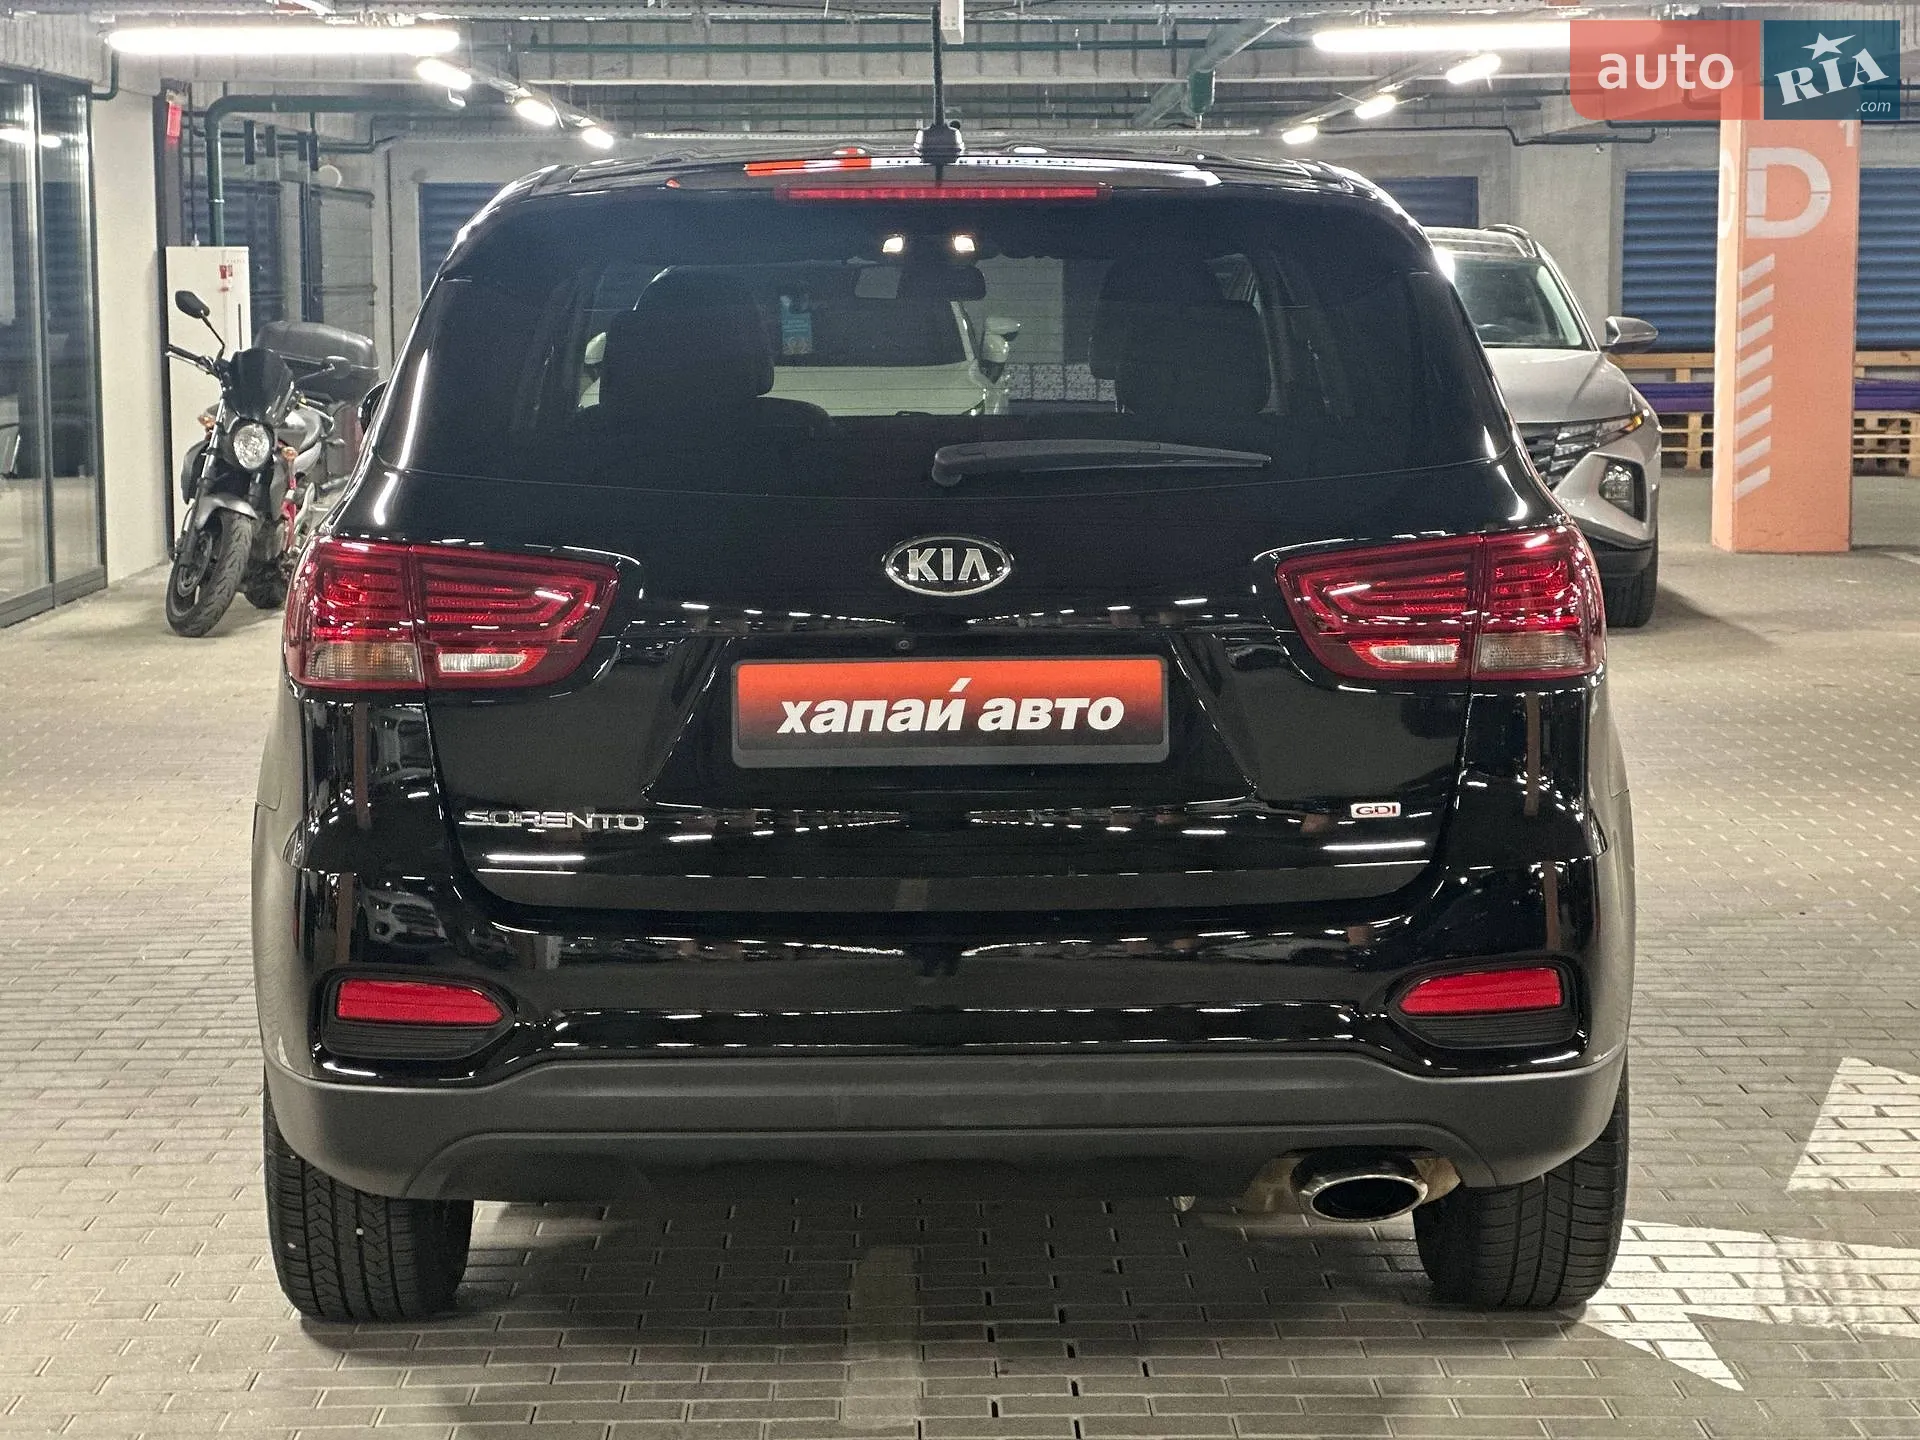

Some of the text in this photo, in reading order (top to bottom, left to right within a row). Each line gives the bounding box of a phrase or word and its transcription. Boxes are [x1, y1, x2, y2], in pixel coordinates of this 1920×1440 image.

[1746, 147, 1832, 239] D
[907, 547, 991, 582] KIA
[977, 696, 1125, 731] авто
[463, 810, 646, 831] SORENTO
[1356, 805, 1397, 816] GDI
